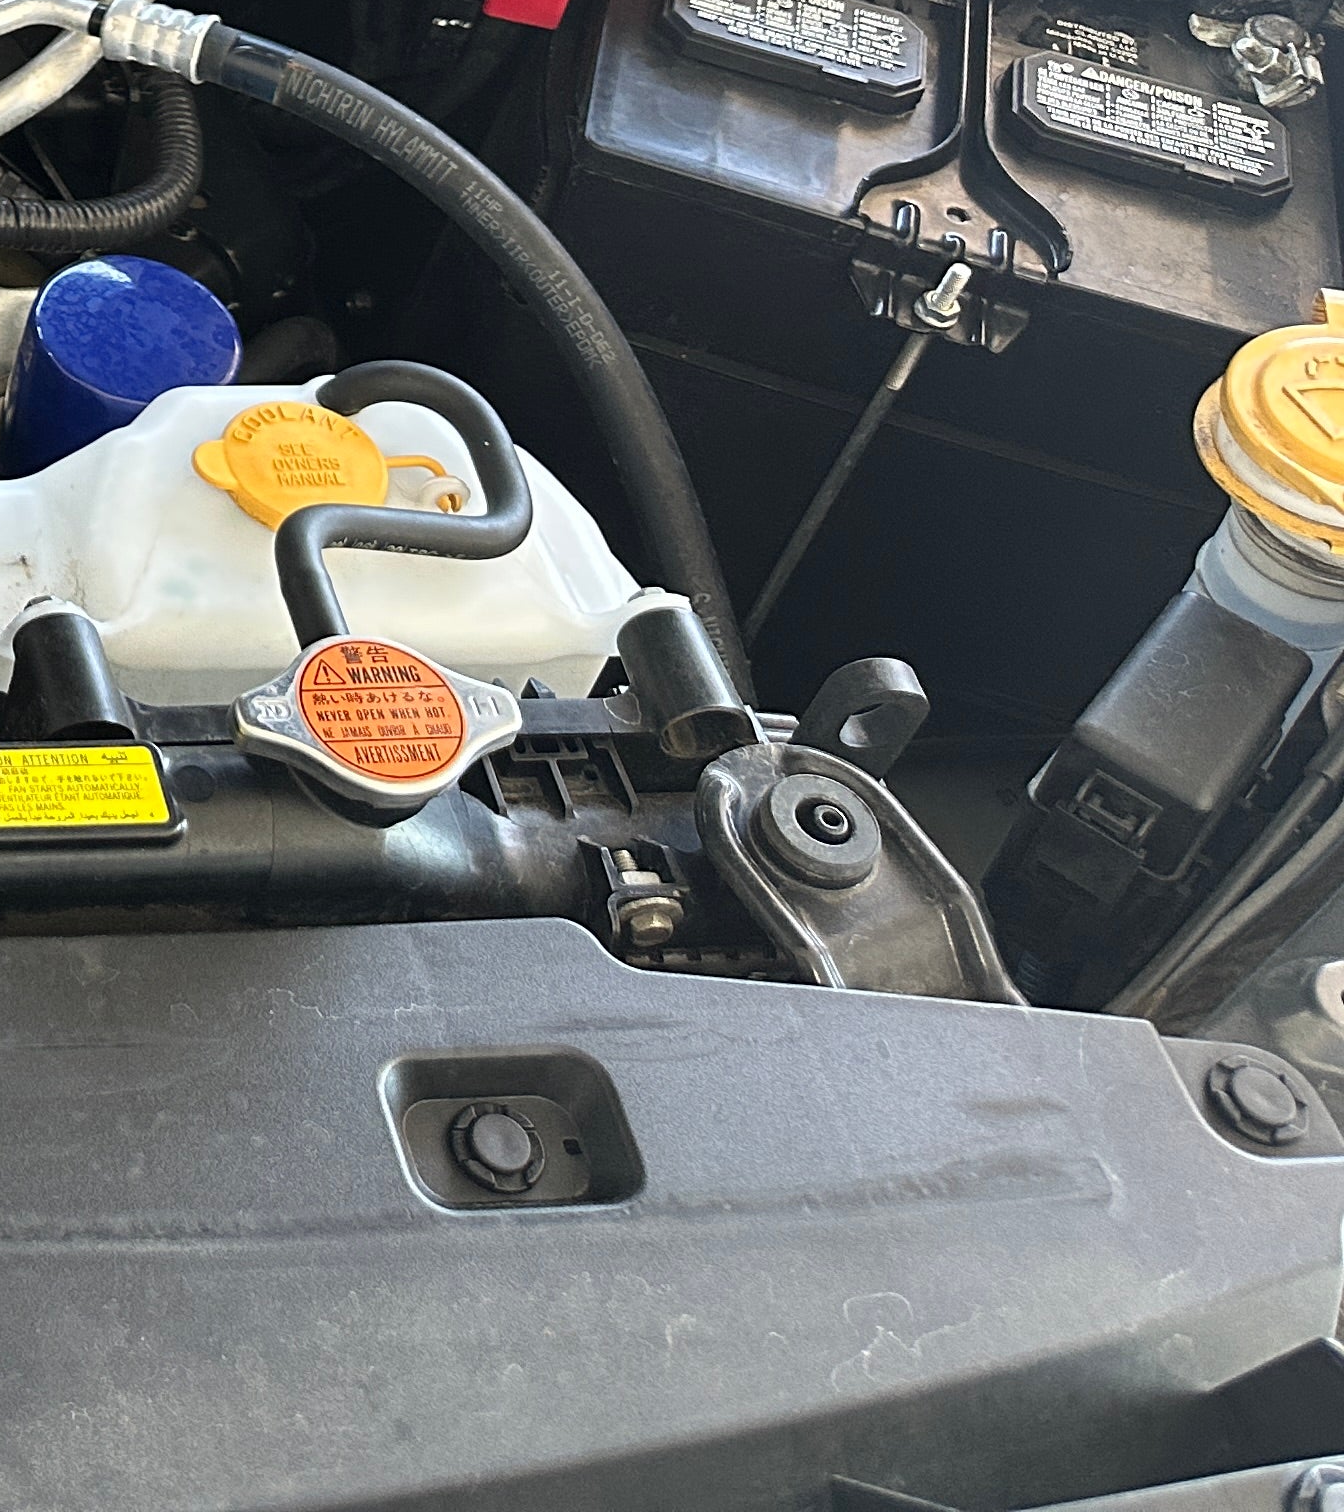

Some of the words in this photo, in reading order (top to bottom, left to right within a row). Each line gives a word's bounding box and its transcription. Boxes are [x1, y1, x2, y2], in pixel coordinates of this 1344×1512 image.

[1099, 70, 1203, 108] DANGER/POISON
[285, 69, 376, 130] NICHIRIN
[371, 116, 459, 185] HYLAMMIT
[233, 405, 359, 443] COOLANT
[278, 443, 313, 457] SEE
[277, 472, 345, 487] MANUAL
[341, 645, 389, 664] 警告
[346, 665, 422, 685] WARNING
[316, 709, 351, 722] NEVER
[356, 708, 385, 721] OPEN
[390, 707, 420, 719] WHEN
[22, 752, 89, 765] ATTENTION
[354, 743, 442, 764] AVERTISSMENT
[8, 784, 28, 793] FAN
[29, 783, 64, 792] STARTS
